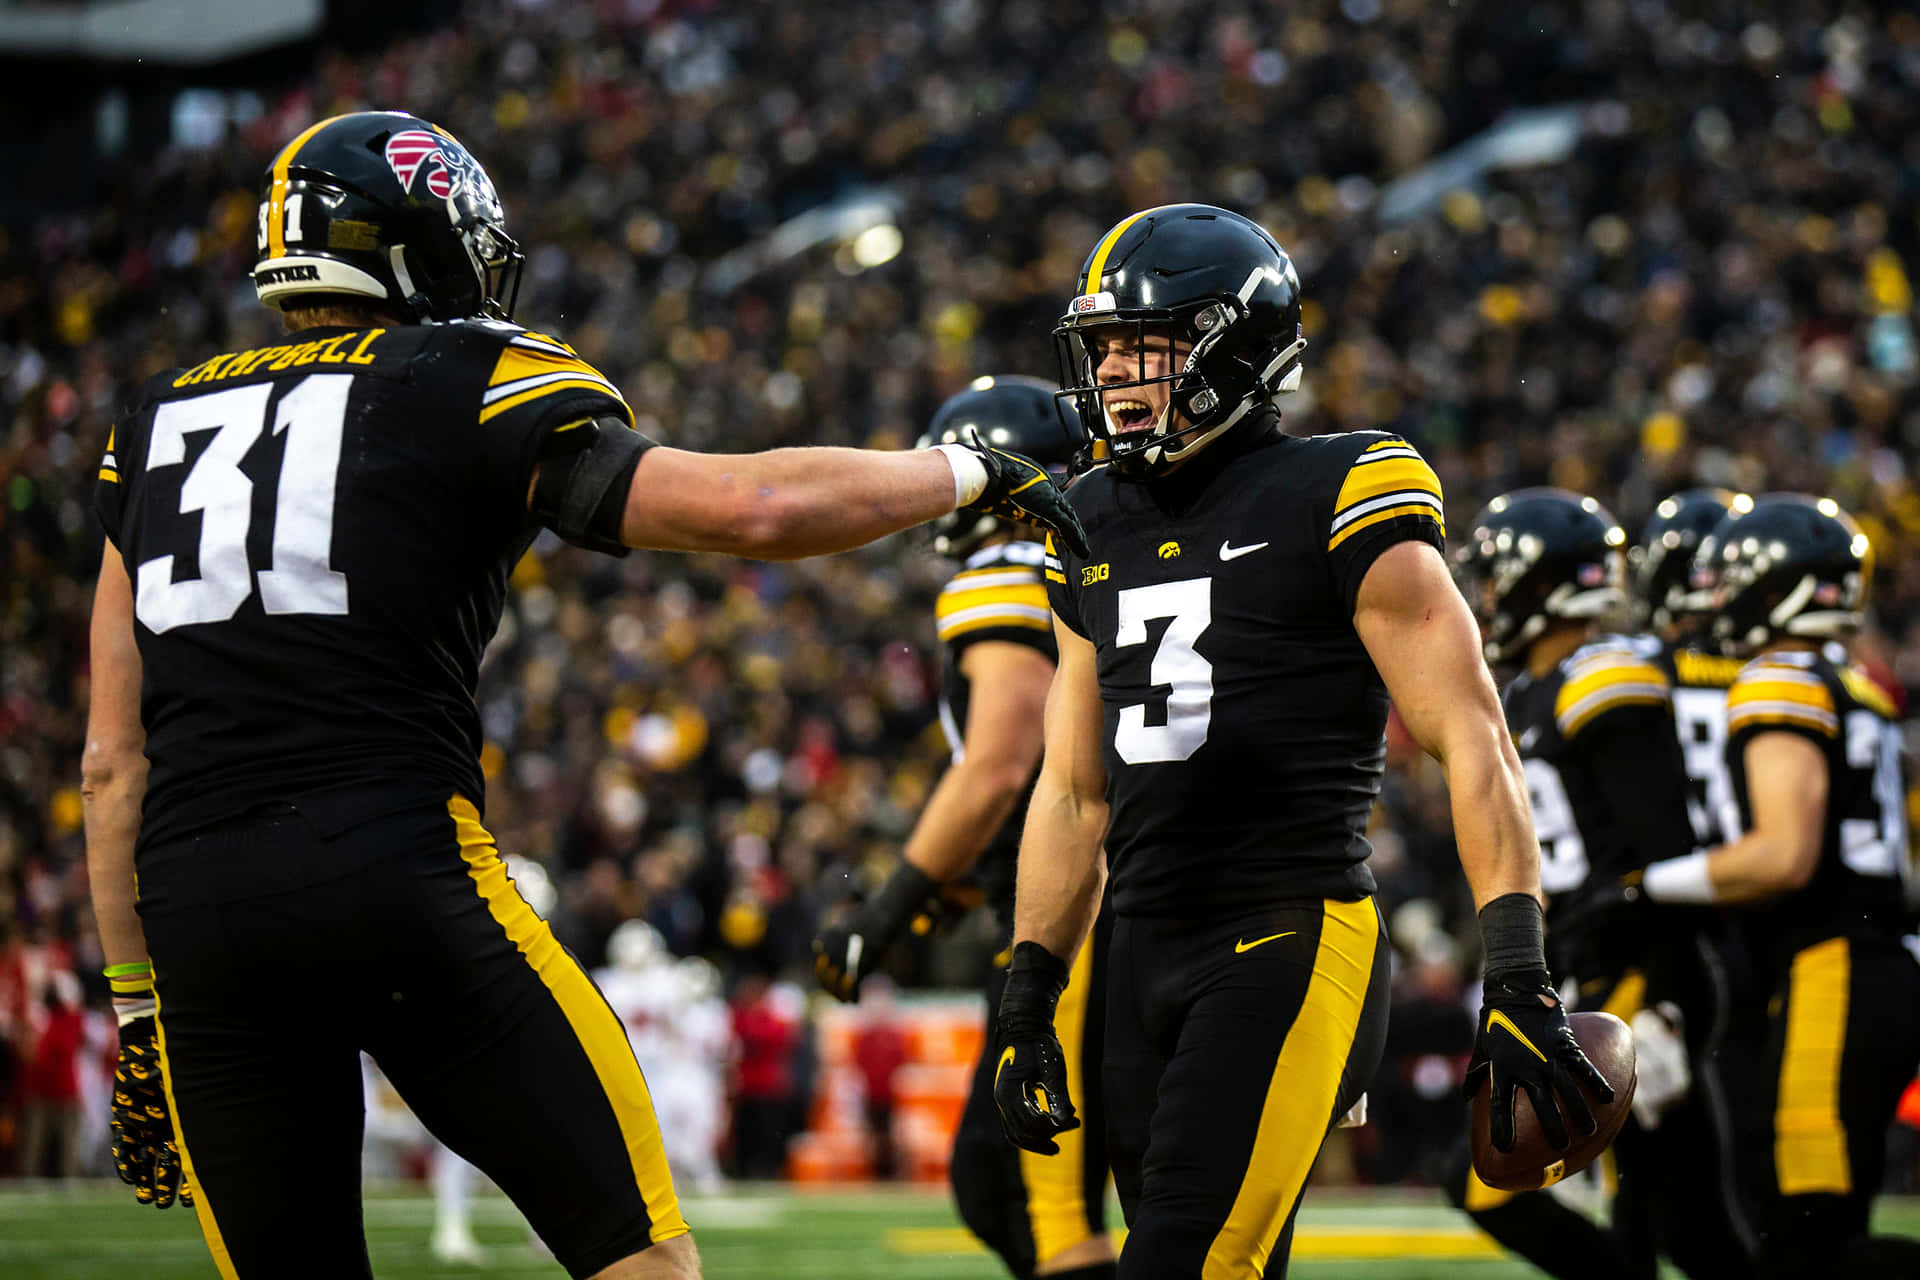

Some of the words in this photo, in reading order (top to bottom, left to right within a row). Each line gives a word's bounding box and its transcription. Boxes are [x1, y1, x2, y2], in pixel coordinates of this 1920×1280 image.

[172, 328, 386, 388] CAMPBELL
[135, 373, 355, 635] 31
[1114, 577, 1214, 765] 3
